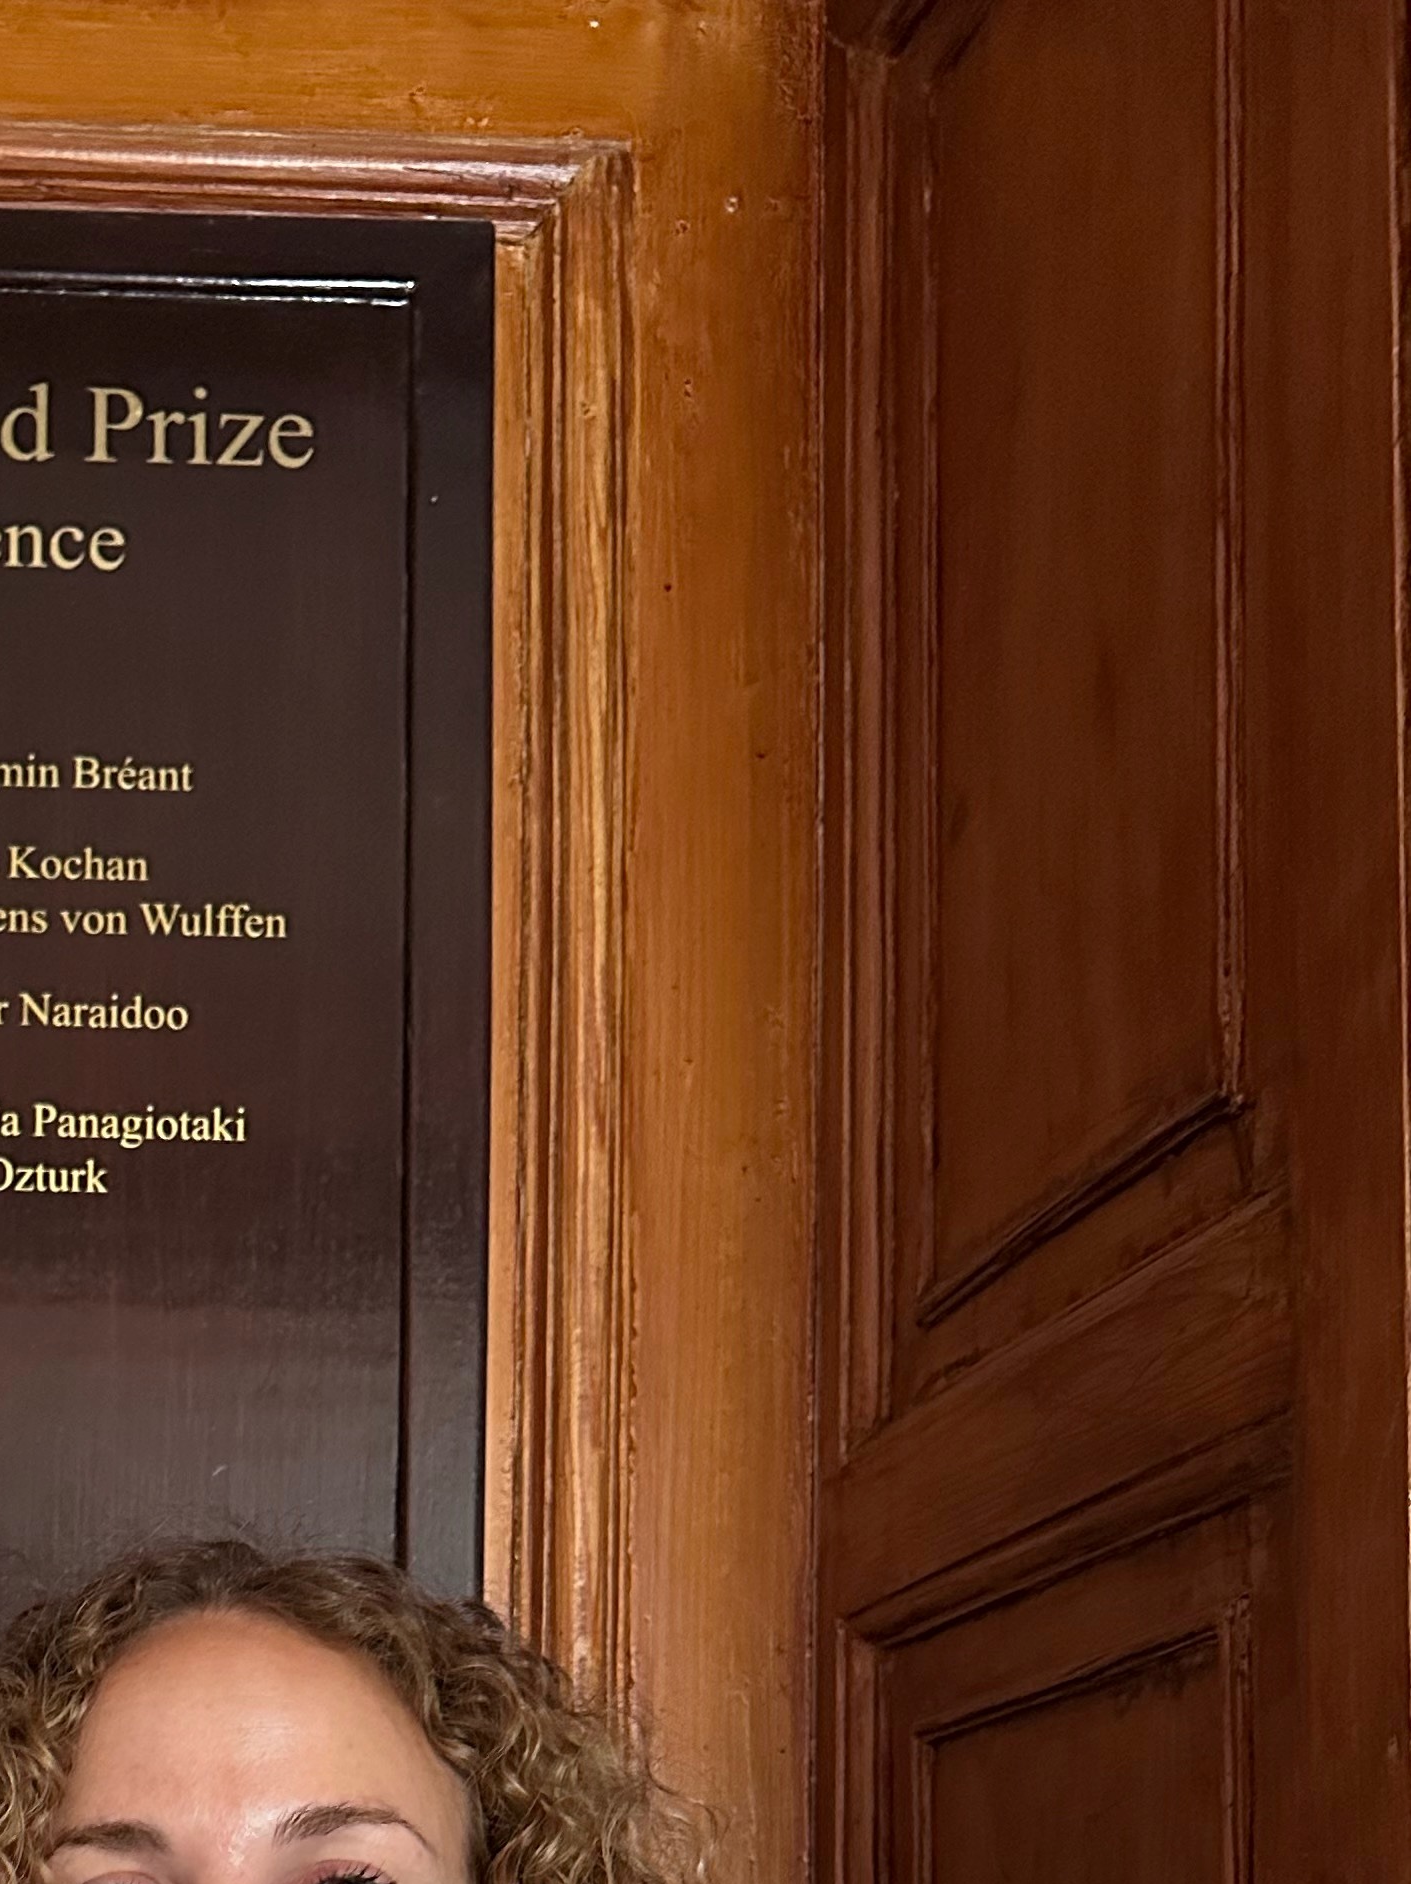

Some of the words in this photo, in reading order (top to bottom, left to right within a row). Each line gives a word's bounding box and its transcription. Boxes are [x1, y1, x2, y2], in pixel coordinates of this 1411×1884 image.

[84, 387, 314, 469] Prize
[74, 756, 192, 792] Bréant
[9, 845, 148, 881] Kochan
[60, 911, 127, 935] von
[140, 903, 286, 938] Wulffen
[19, 992, 189, 1031] Naraidoo
[34, 1103, 245, 1149] Panagiotaki
